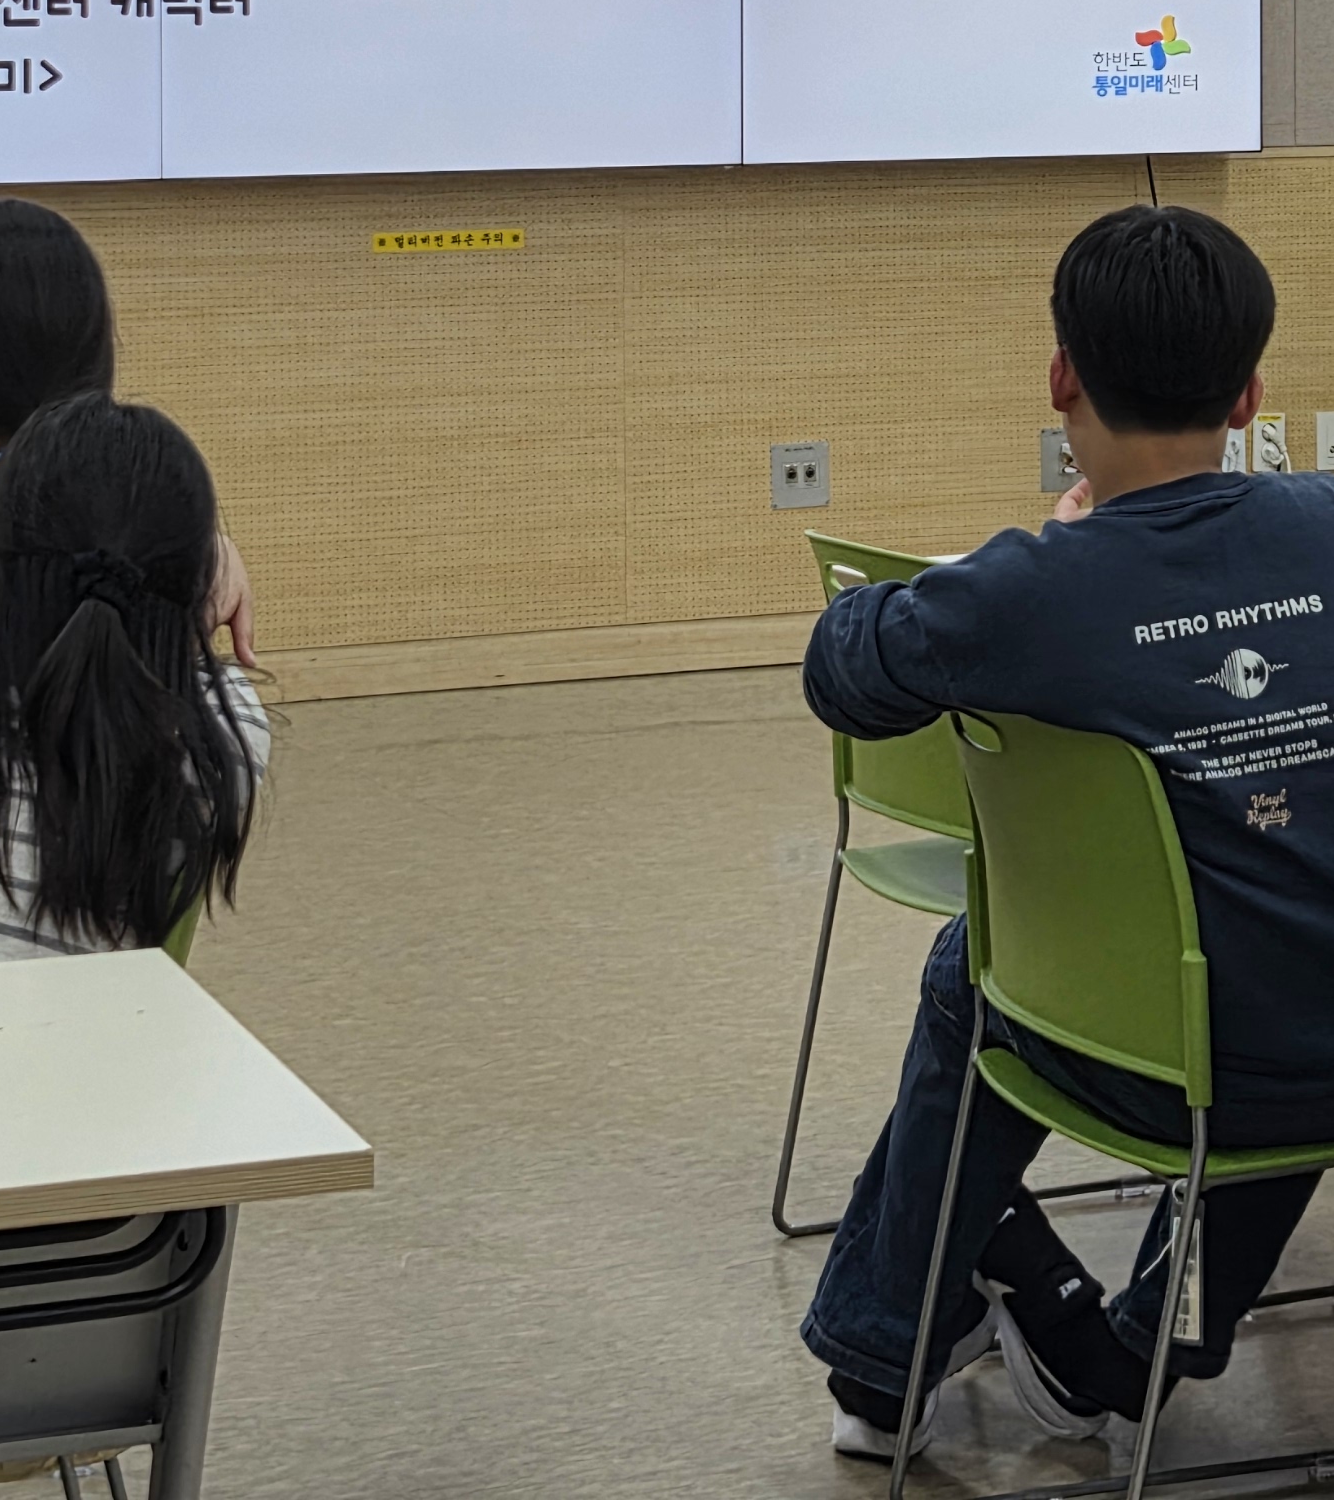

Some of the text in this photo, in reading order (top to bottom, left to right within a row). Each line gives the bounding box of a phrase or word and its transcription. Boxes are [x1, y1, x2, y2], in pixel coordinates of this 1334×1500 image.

[1092, 51, 1148, 72] 한반도
[1092, 74, 1199, 97] 통일미래센터
[1134, 594, 1324, 644] RETRO RHYTHMS
[1173, 702, 1328, 739] ANALOG DREAMS IN A DIGITAL WORLD
[1220, 728, 1266, 745] CASSETTE
[1267, 720, 1305, 736] DREAMS
[1200, 739, 1318, 769] THE BEAT NEVER STOPS
[1205, 765, 1243, 780] ANALOG
[1243, 758, 1278, 774] MEETS
